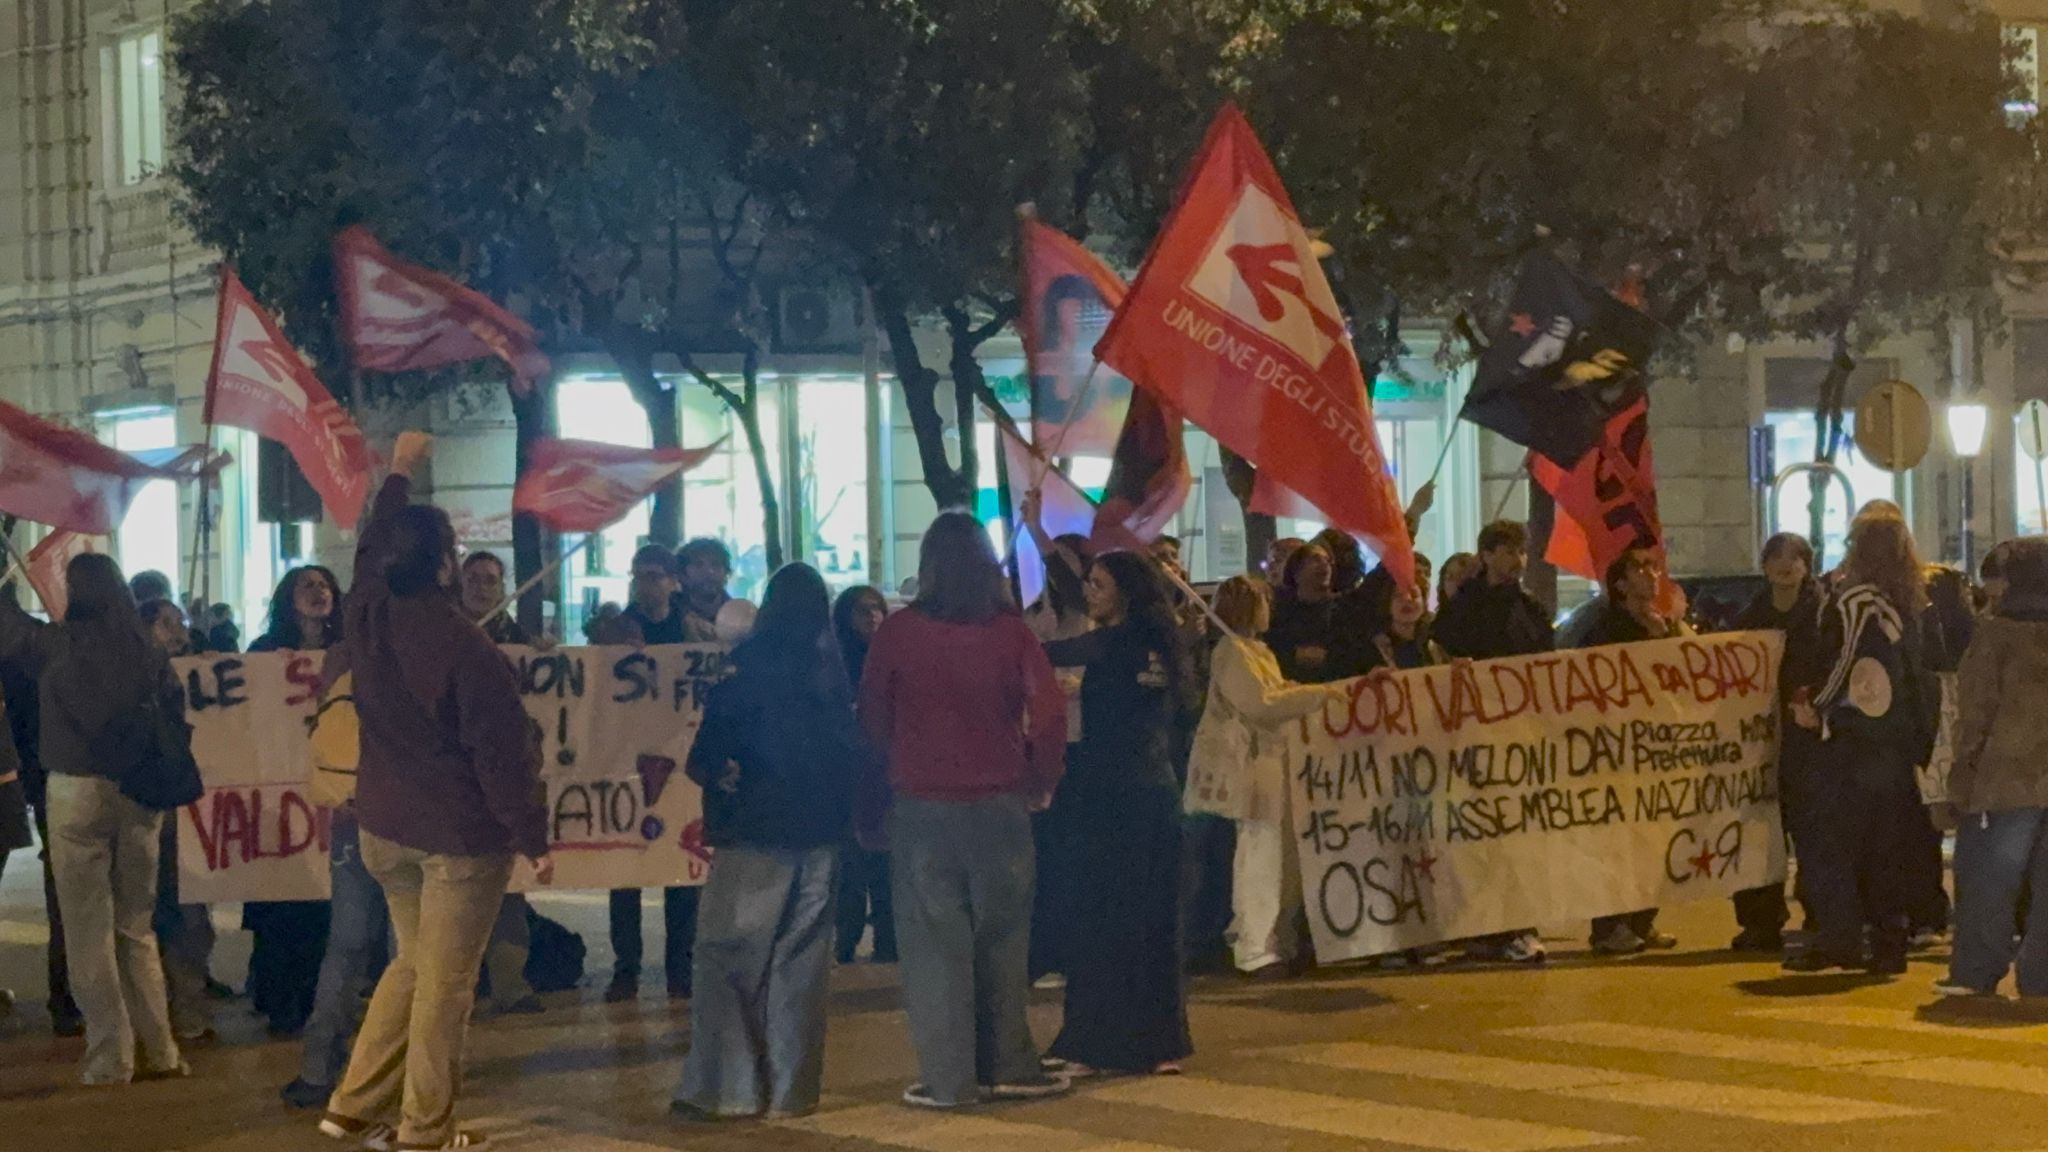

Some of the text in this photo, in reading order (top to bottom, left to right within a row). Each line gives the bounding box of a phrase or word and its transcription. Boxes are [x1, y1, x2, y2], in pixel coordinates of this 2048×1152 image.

[1163, 299, 1258, 371] UNIONE
[1255, 355, 1326, 415] DEGLI
[188, 659, 249, 711] LE
[285, 657, 322, 706] S
[613, 652, 660, 702] SI
[1424, 649, 1655, 733] VALDITARA
[1679, 641, 1770, 703] BARI
[1298, 723, 1626, 801] 14/11 NO MELONI DAY
[1631, 719, 1718, 743] Piazza
[188, 788, 332, 872] VALDI
[553, 753, 677, 841] ATO!
[1446, 784, 1626, 843] ASSEMBLEA
[1634, 762, 1778, 823] NAZIONALE
[1318, 853, 1426, 939] OSA
